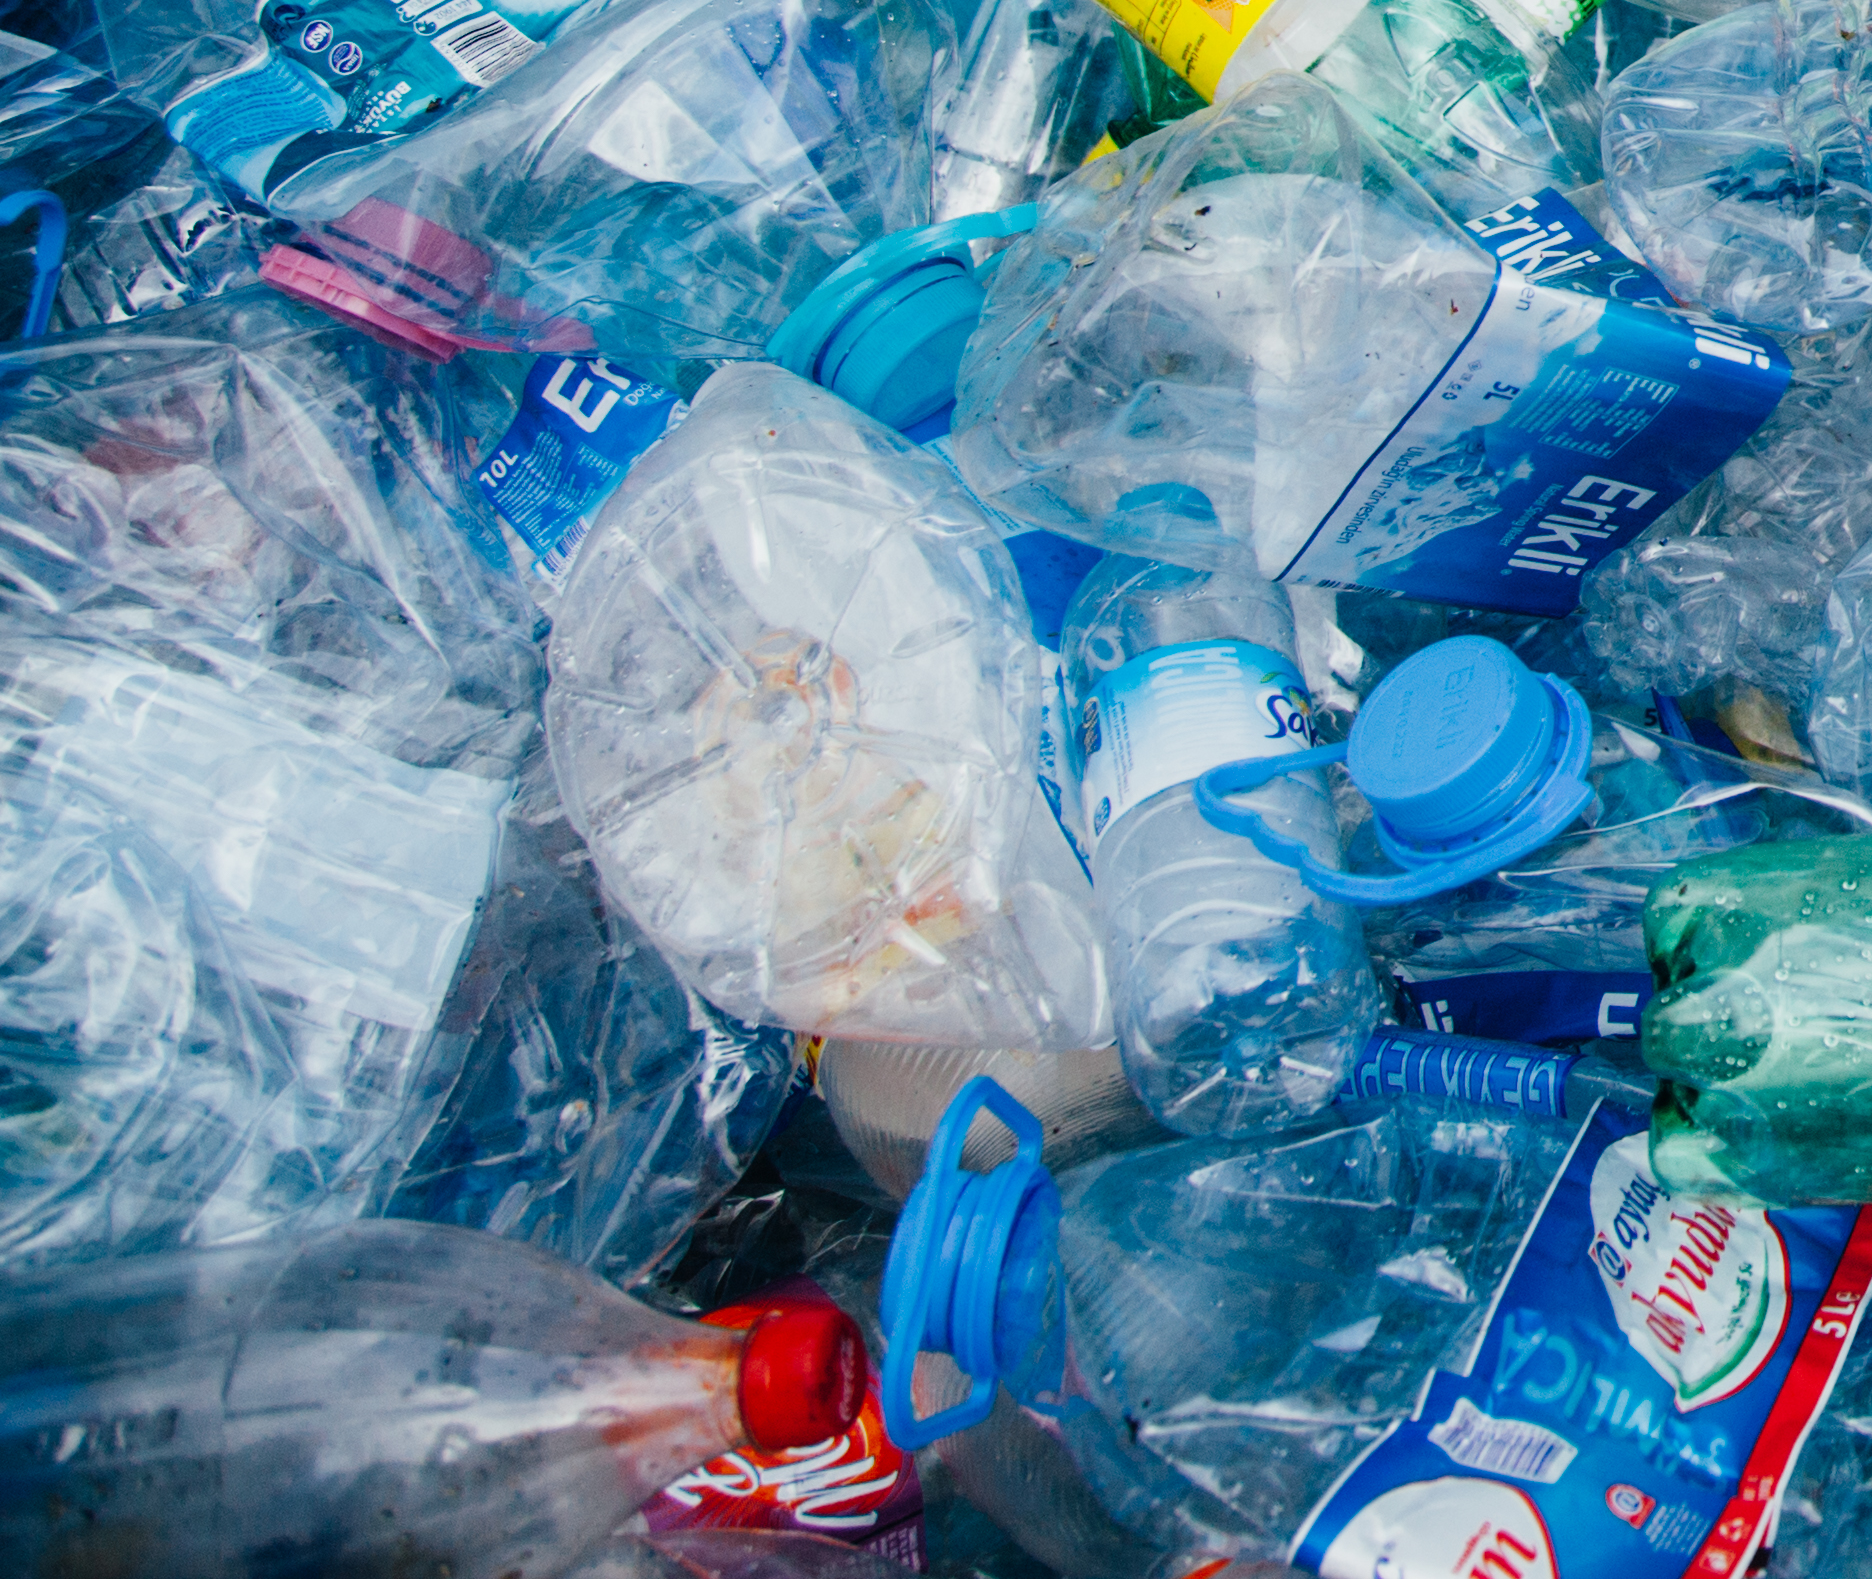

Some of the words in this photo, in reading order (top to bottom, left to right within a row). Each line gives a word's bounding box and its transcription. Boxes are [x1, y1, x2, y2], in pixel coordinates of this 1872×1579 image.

[1482, 380, 1525, 403] 5L
[479, 449, 520, 489] 10L
[1509, 476, 1656, 576] Erikli
[1614, 1167, 1674, 1251] ayta
[1650, 1196, 1743, 1357] akyudu
